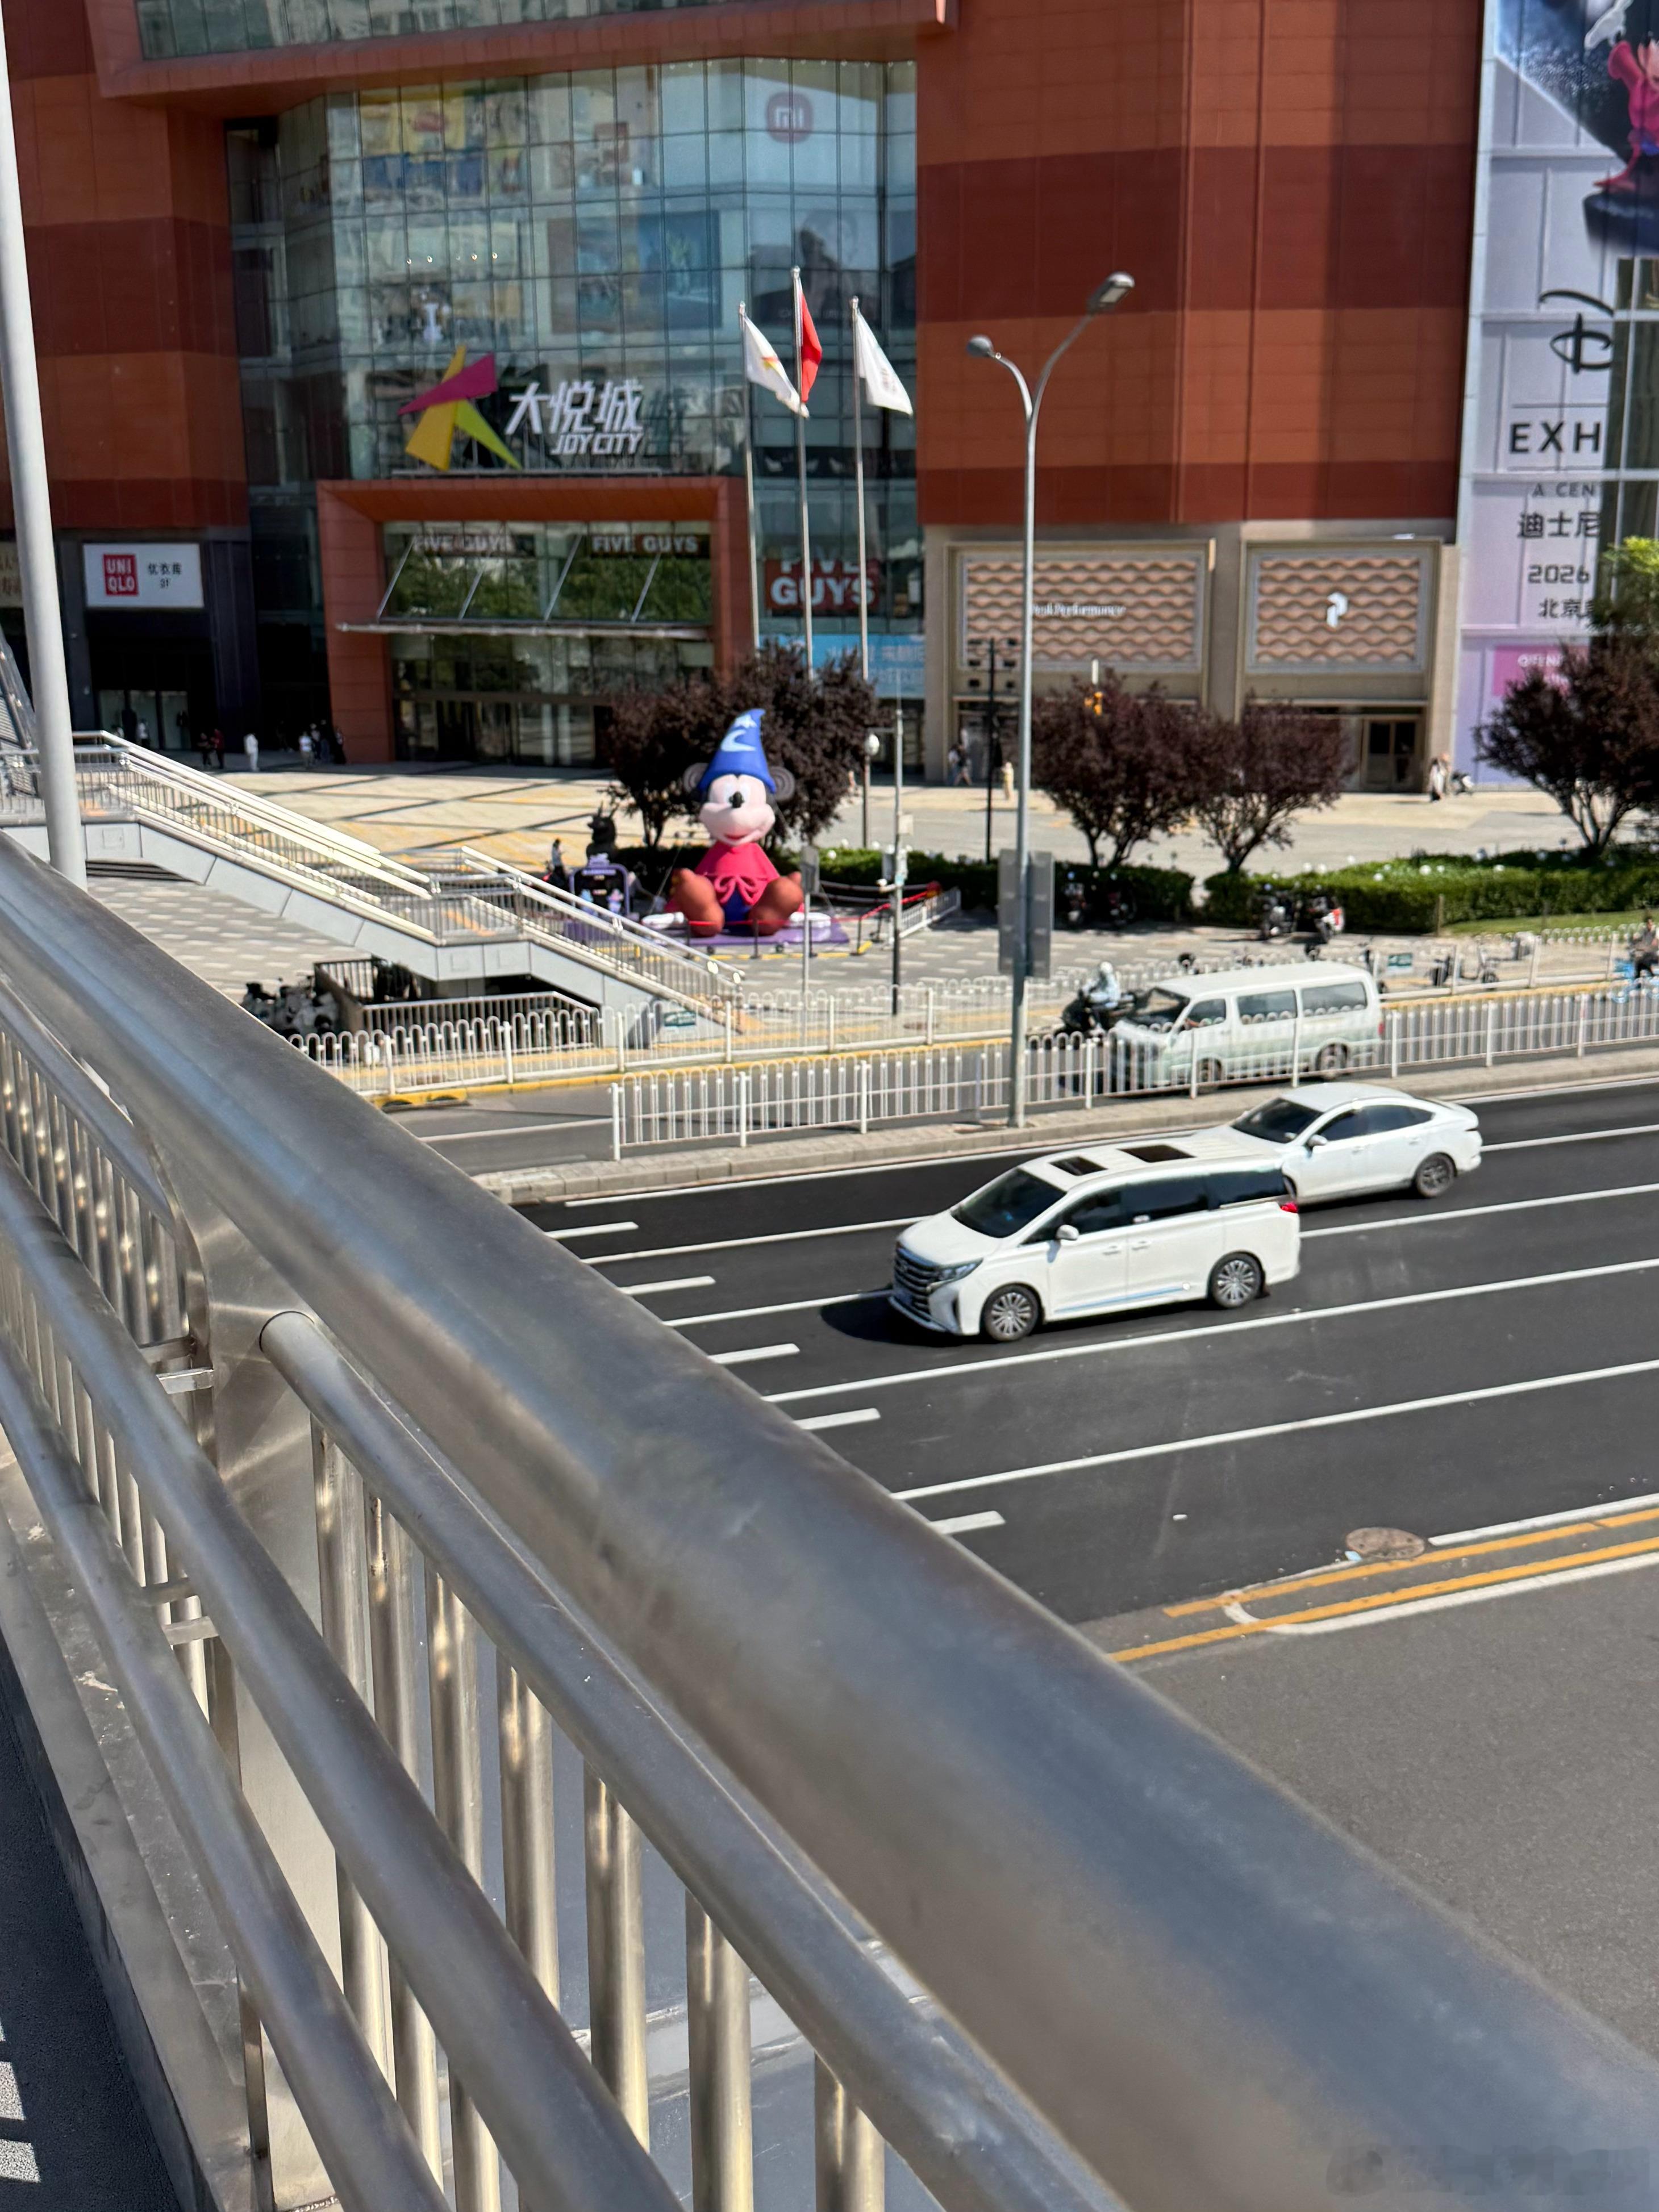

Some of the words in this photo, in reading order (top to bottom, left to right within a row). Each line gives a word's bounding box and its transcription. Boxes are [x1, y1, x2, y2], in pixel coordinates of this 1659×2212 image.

[505, 379, 645, 435] 大悦城
[551, 433, 594, 454] JOY
[591, 433, 644, 454] CITY
[1510, 421, 1601, 453] EXH
[1533, 484, 1544, 497] A
[1556, 482, 1595, 498] CEN
[1518, 511, 1601, 537] 迪士尼
[106, 558, 132, 574] UNI
[1527, 565, 1590, 584] 2026
[108, 575, 135, 593] QLO
[770, 576, 876, 606] GUYS
